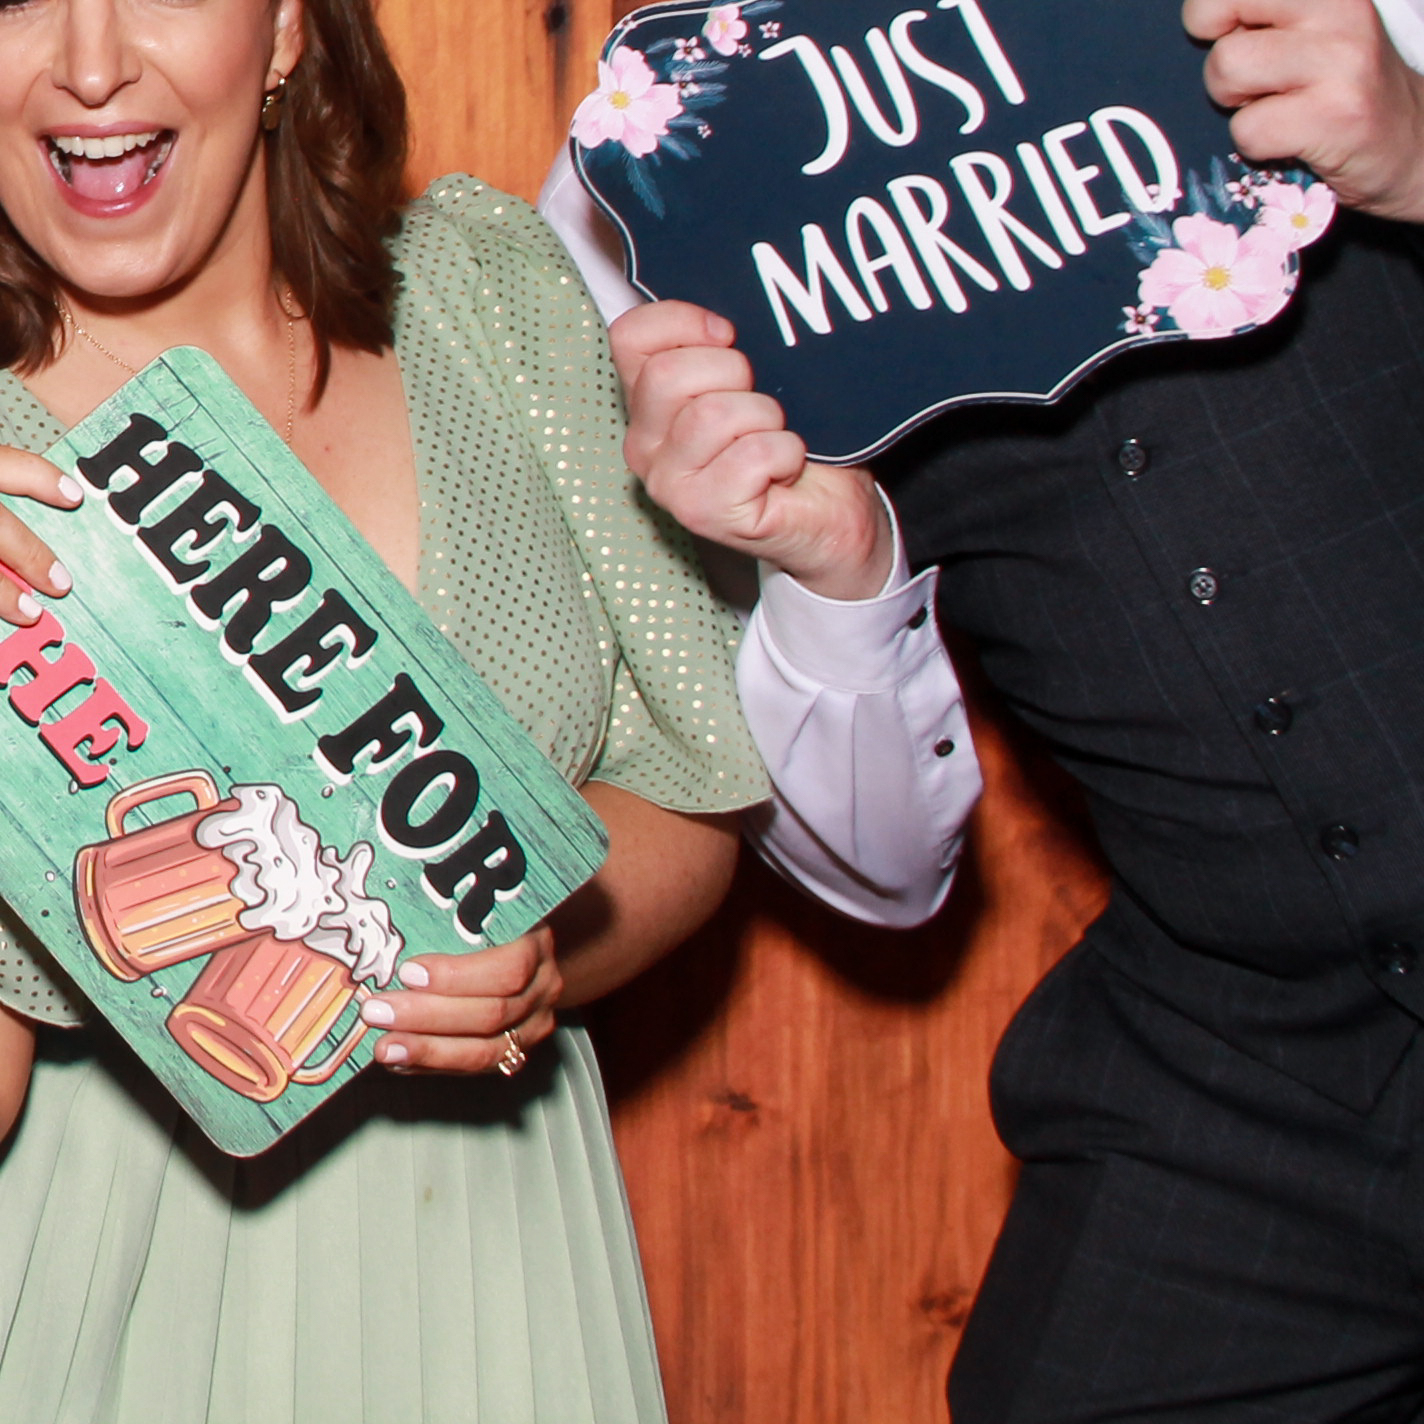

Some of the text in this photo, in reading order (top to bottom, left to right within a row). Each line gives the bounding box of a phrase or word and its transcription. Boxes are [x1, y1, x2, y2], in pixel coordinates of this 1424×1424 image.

[751, 105, 1181, 347] MARRIED
[75, 411, 527, 945] HERE FOR
